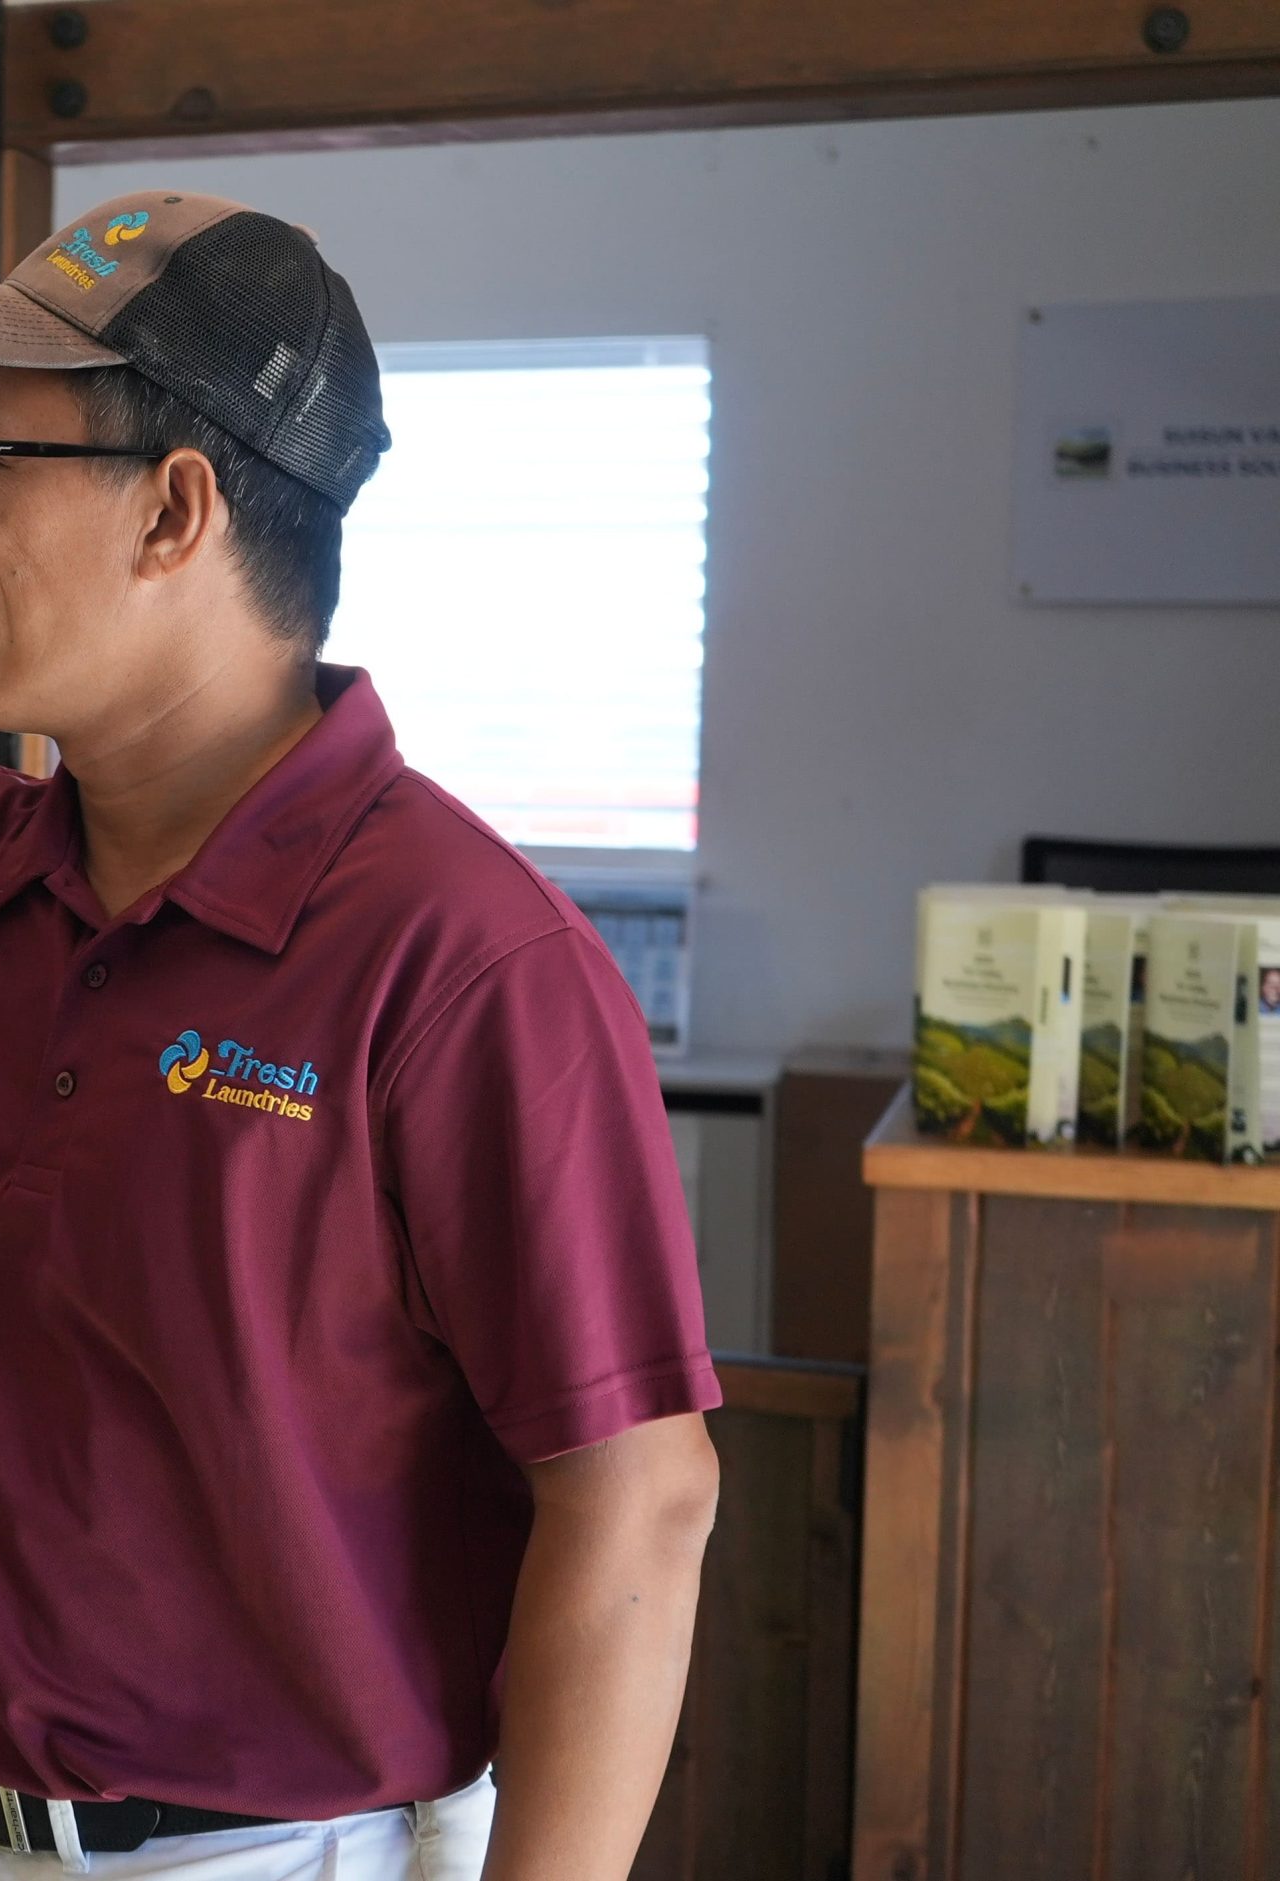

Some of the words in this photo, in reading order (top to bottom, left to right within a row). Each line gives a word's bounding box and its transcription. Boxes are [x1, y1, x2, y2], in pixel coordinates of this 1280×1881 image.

[46, 248, 95, 290] Laundries
[58, 226, 120, 277] Fresh
[209, 1039, 319, 1095] Fresh
[201, 1078, 313, 1121] Laundries
